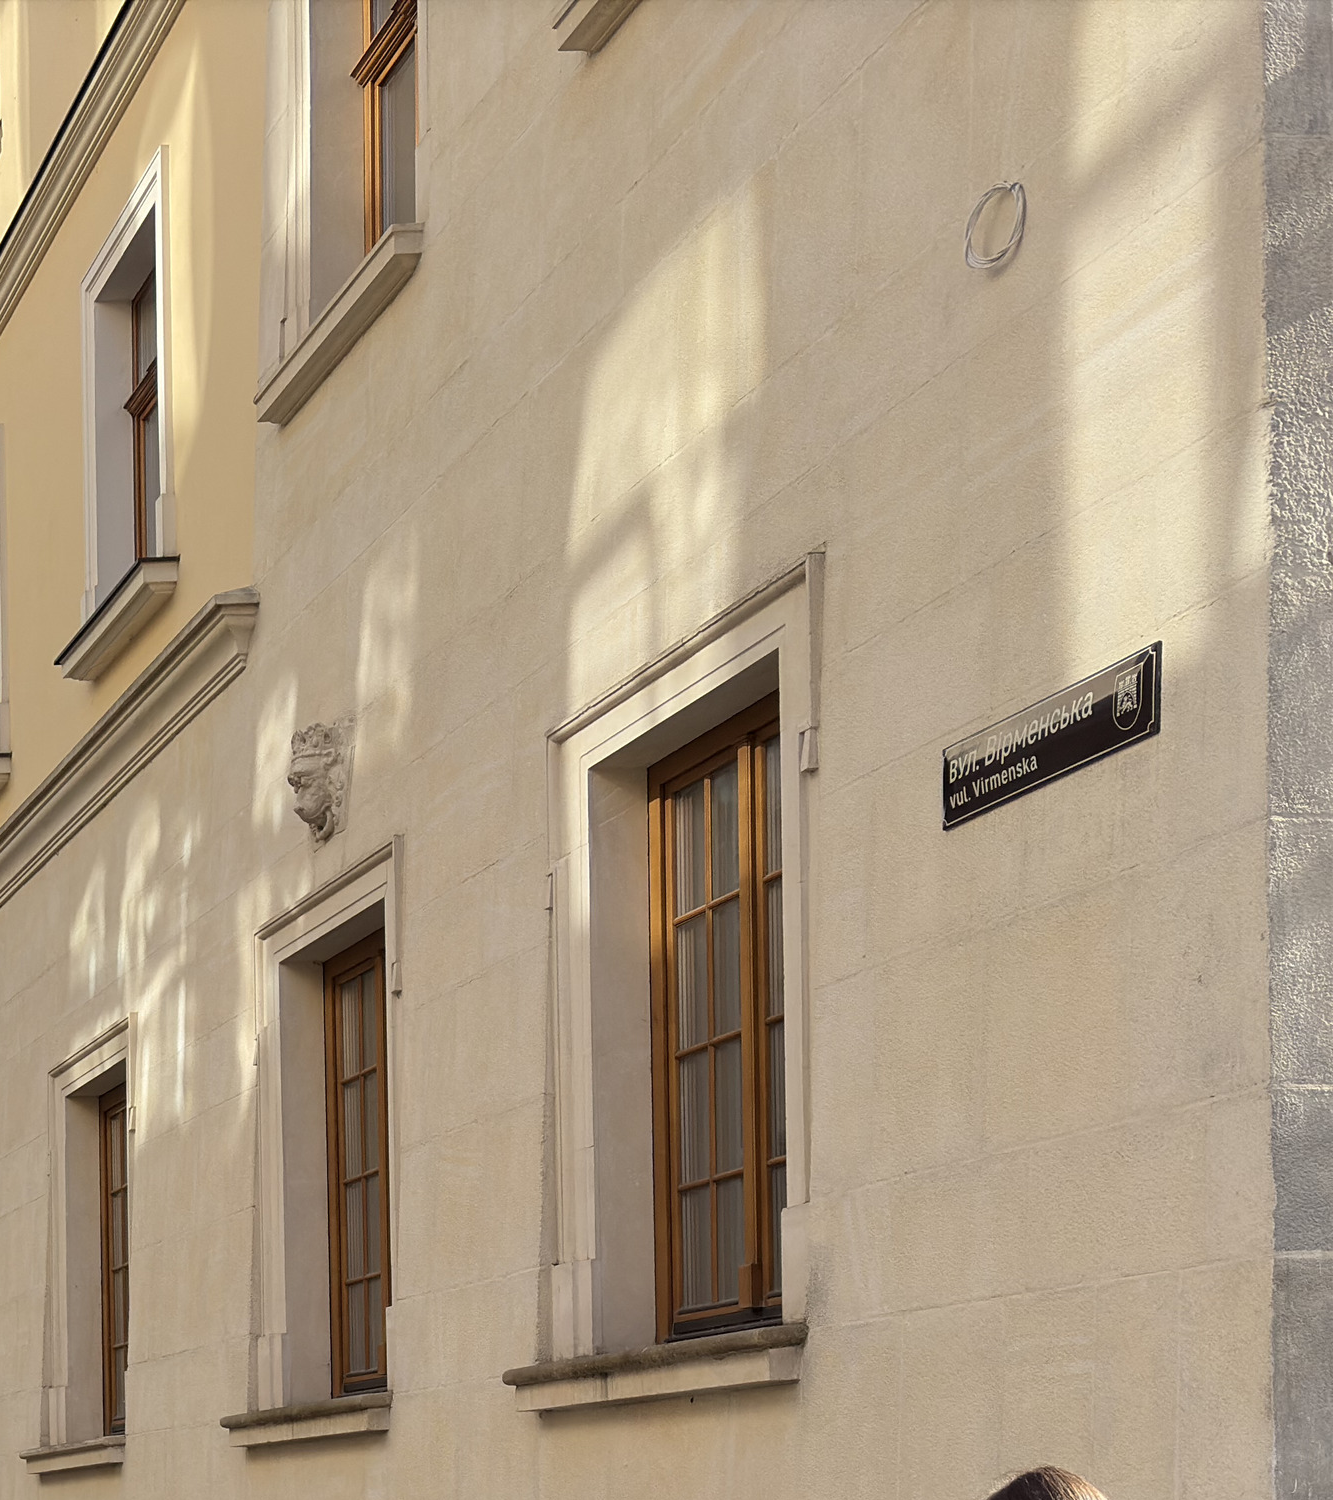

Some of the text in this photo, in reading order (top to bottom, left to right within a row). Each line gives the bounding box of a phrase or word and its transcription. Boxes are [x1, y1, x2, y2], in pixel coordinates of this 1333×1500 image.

[984, 691, 1094, 766] Вірменська
[949, 755, 1039, 809] vul. Virmenska
